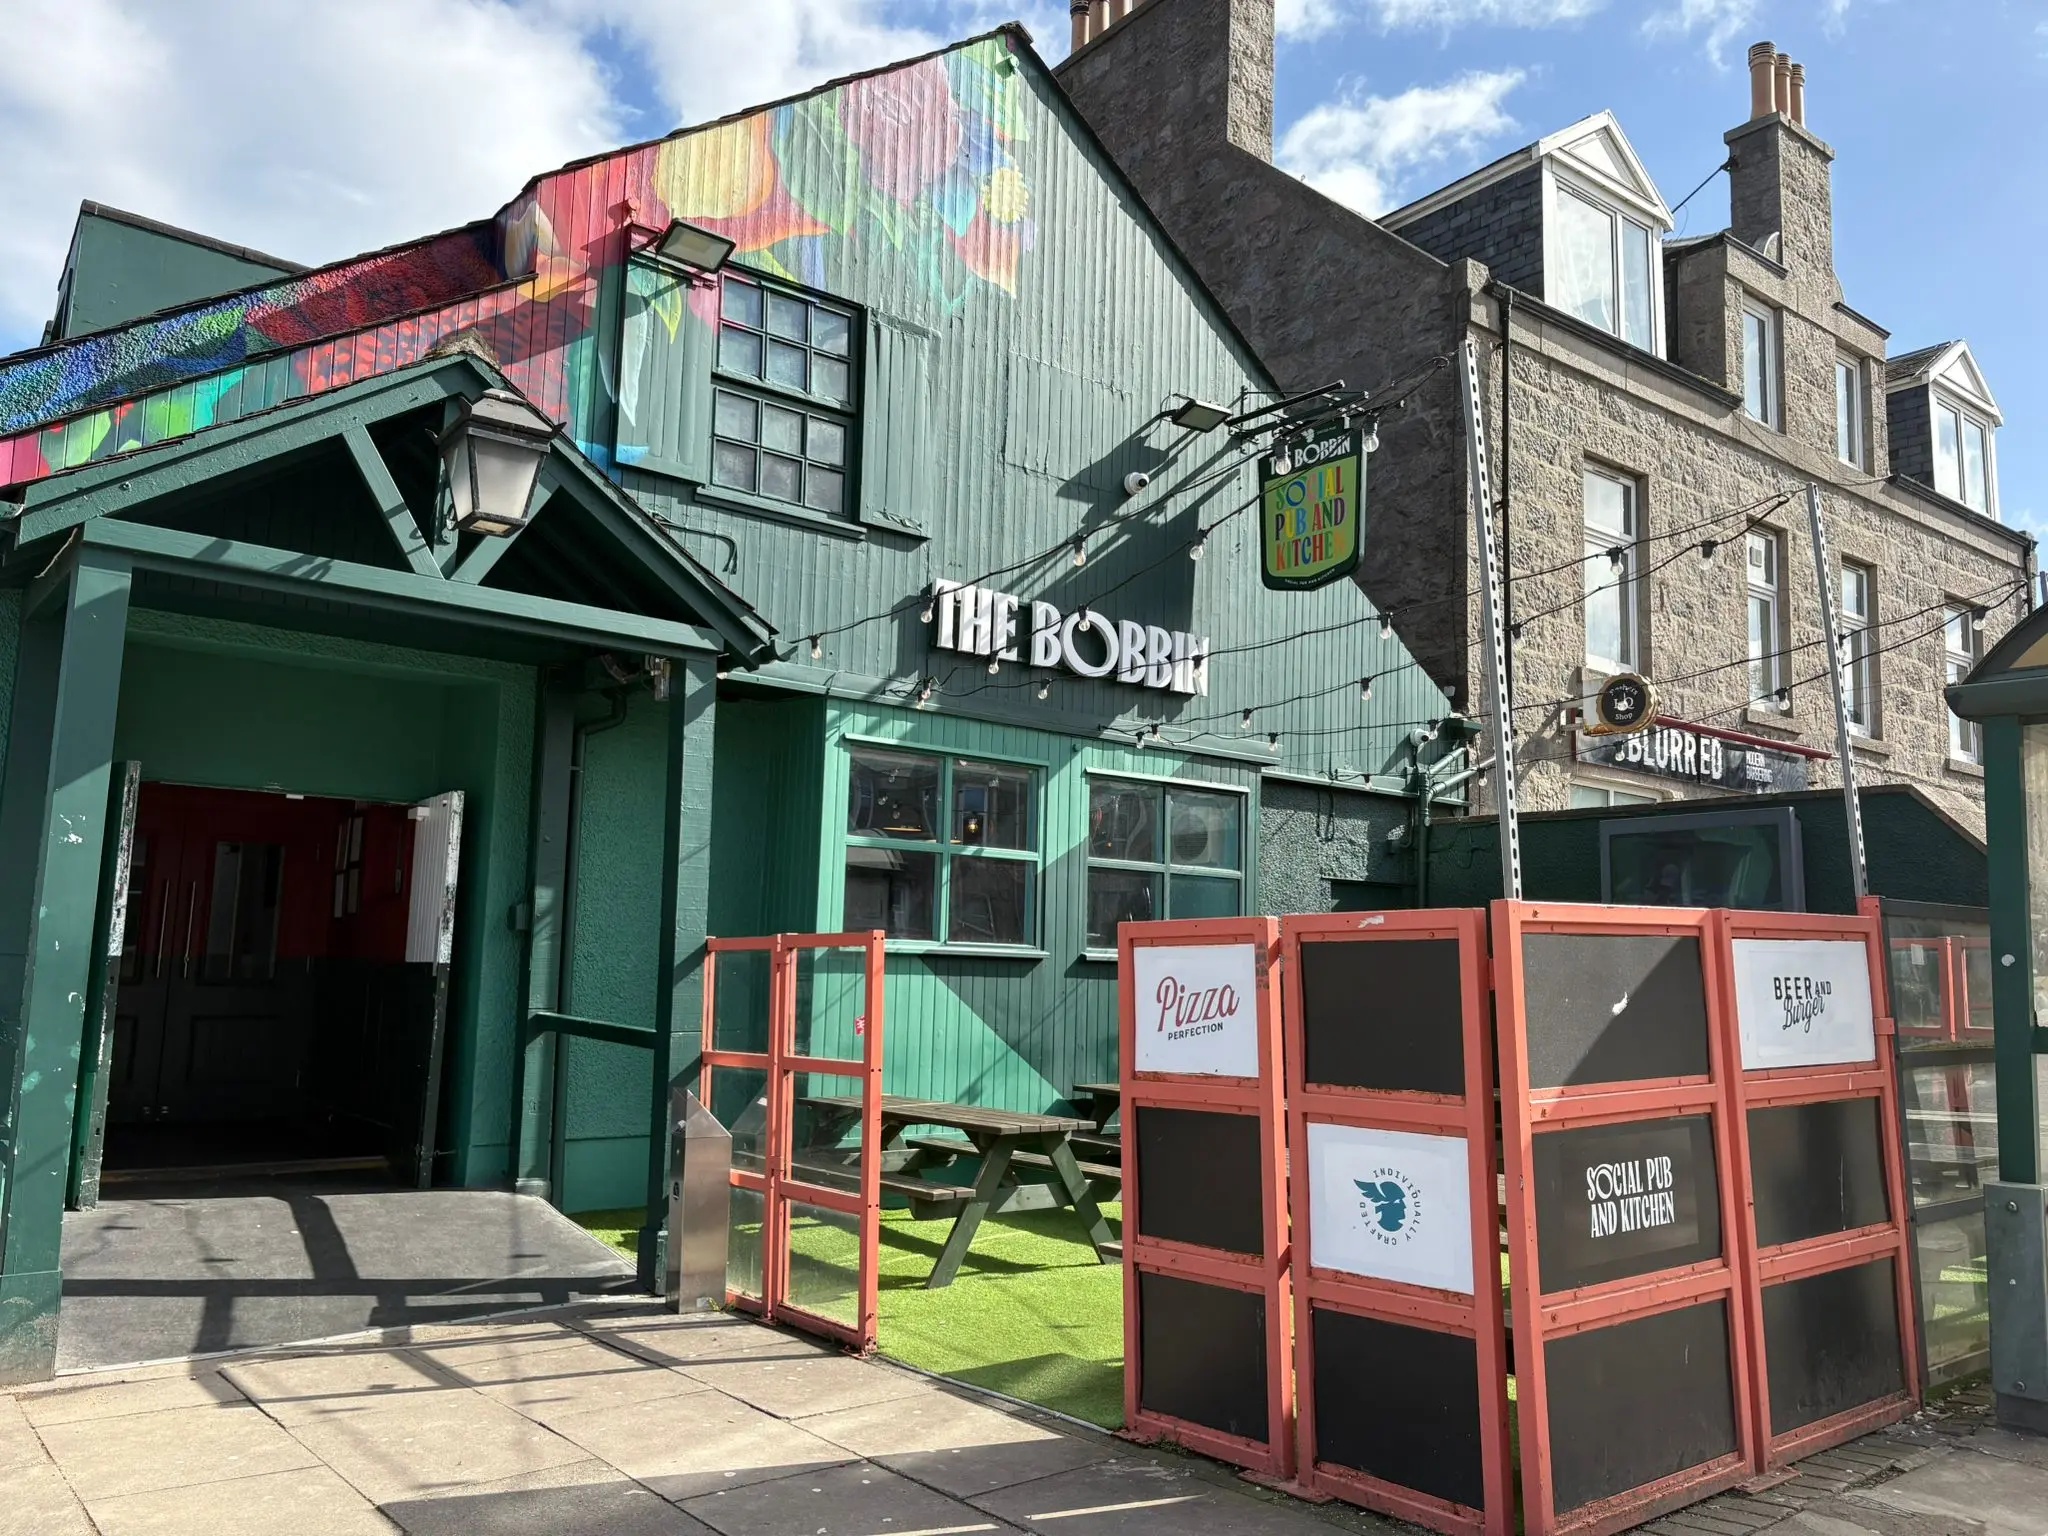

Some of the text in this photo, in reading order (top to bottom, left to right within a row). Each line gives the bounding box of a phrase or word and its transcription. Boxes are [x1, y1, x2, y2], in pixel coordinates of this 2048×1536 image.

[1294, 435, 1351, 468] BOBBIN
[1276, 466, 1344, 511] SOCIAL
[1275, 497, 1345, 541] PUB AND
[1276, 530, 1346, 571] KITCHEN
[932, 577, 1210, 697] THE BOBBIN
[1614, 712, 1633, 720] Shop
[1627, 725, 1723, 780] BLURRED
[1156, 976, 1240, 1032] Pizza
[1773, 977, 1832, 1001] BEER AND
[1168, 1022, 1224, 1041] PERFECTION
[1782, 994, 1825, 1034] Burger
[1586, 1156, 1673, 1202] SOCIAL PUB
[1359, 1167, 1421, 1246] INDIVIDUALLY CRAFTED
[1591, 1190, 1675, 1238] AND KITCHEN
